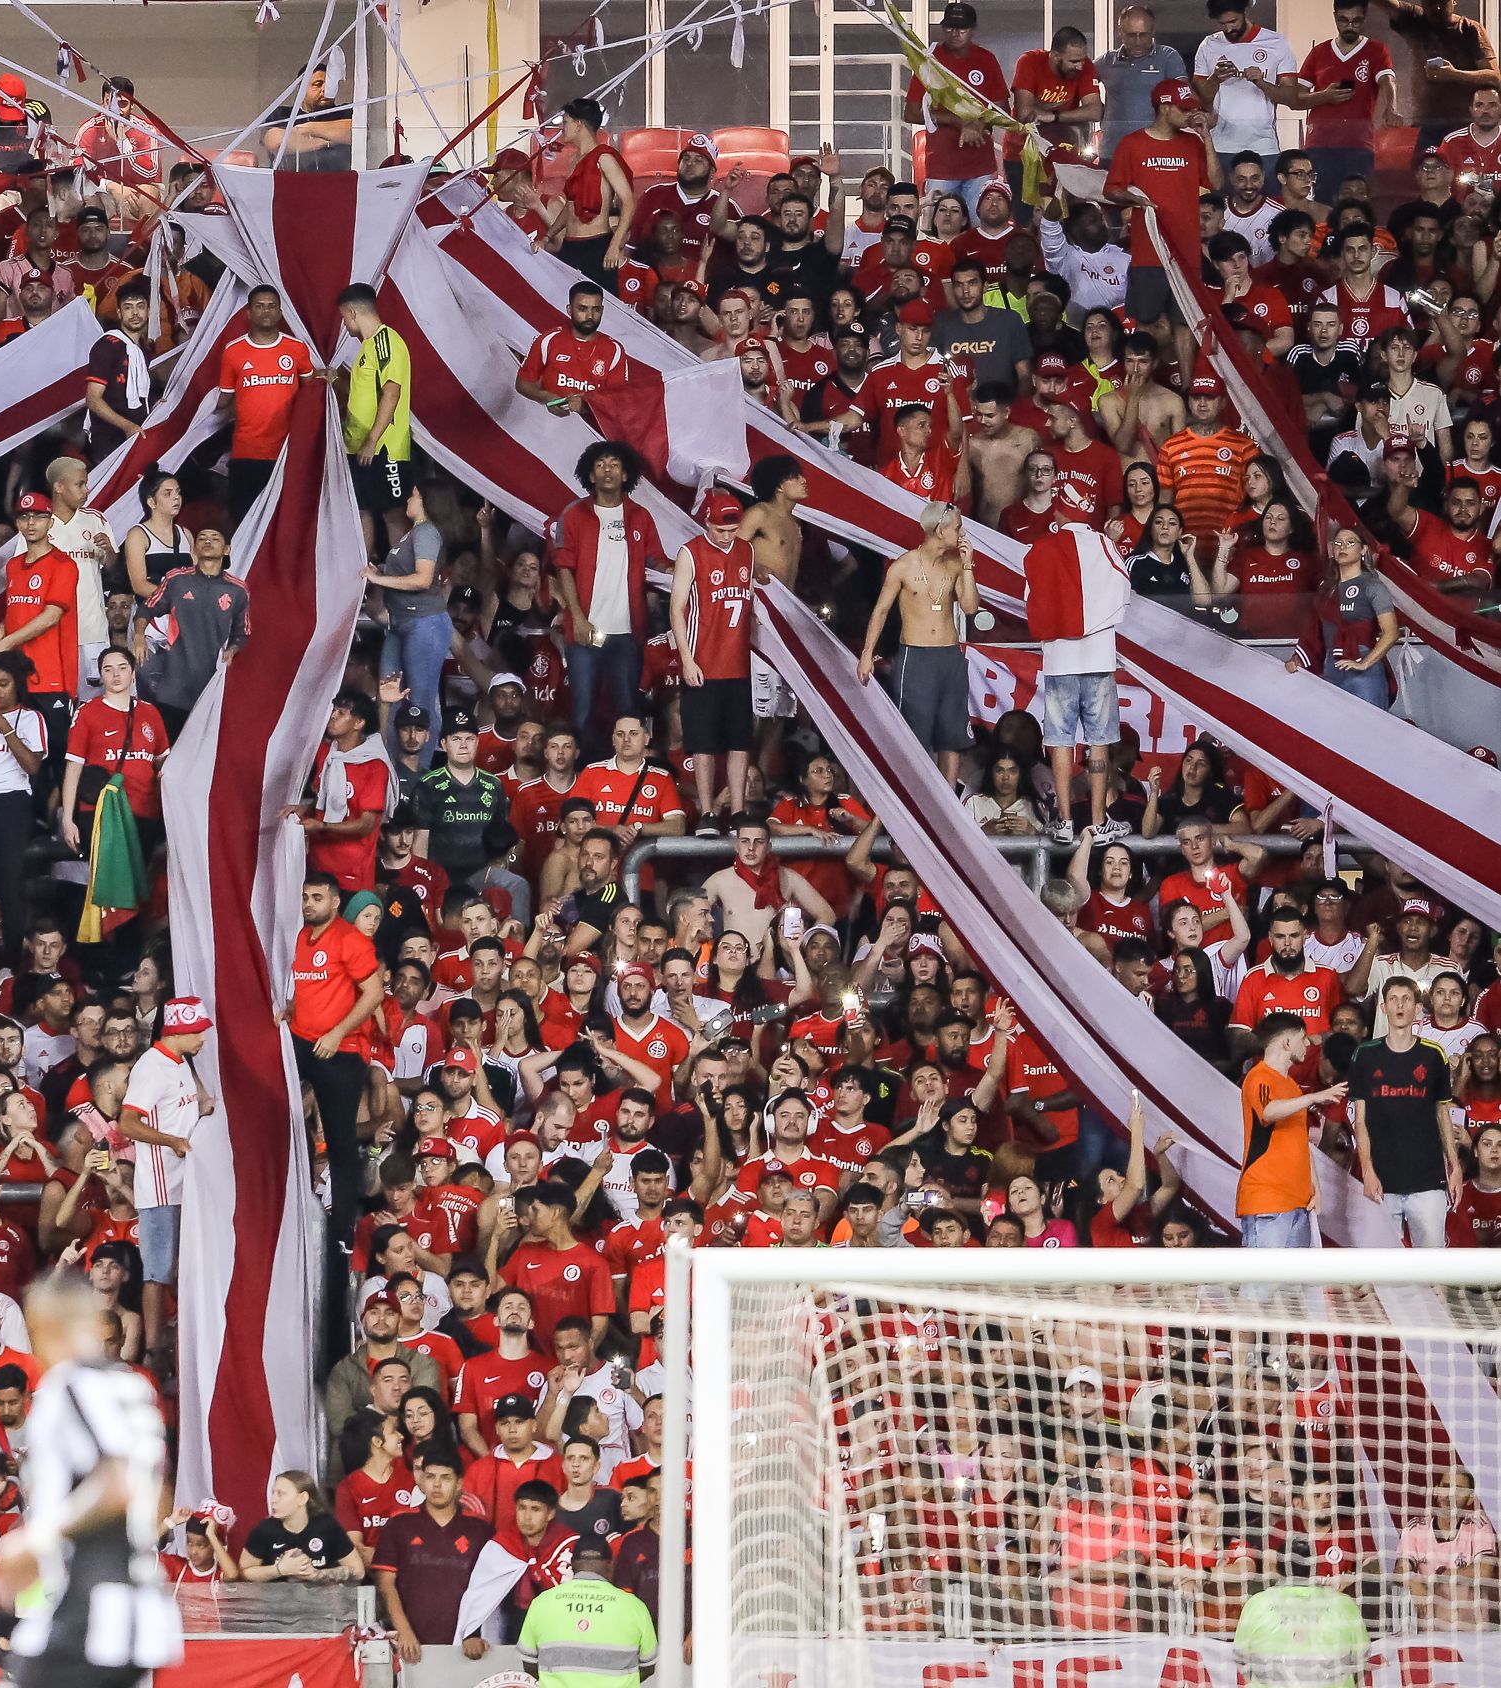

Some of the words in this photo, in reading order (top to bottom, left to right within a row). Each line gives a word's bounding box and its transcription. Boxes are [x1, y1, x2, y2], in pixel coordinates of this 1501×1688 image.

[1147, 157, 1186, 168] ALVORADA
[950, 339, 996, 353] OAKLEY
[251, 374, 294, 388] Banrisul
[557, 374, 596, 391] Banris
[389, 458, 402, 498] adid
[1259, 572, 1293, 584] Banrisul
[724, 602, 743, 627] 7
[456, 810, 491, 822] banris
[293, 970, 328, 981] banrisul
[555, 1591, 616, 1603] ORIENTADOR
[567, 1603, 604, 1614] 1014
